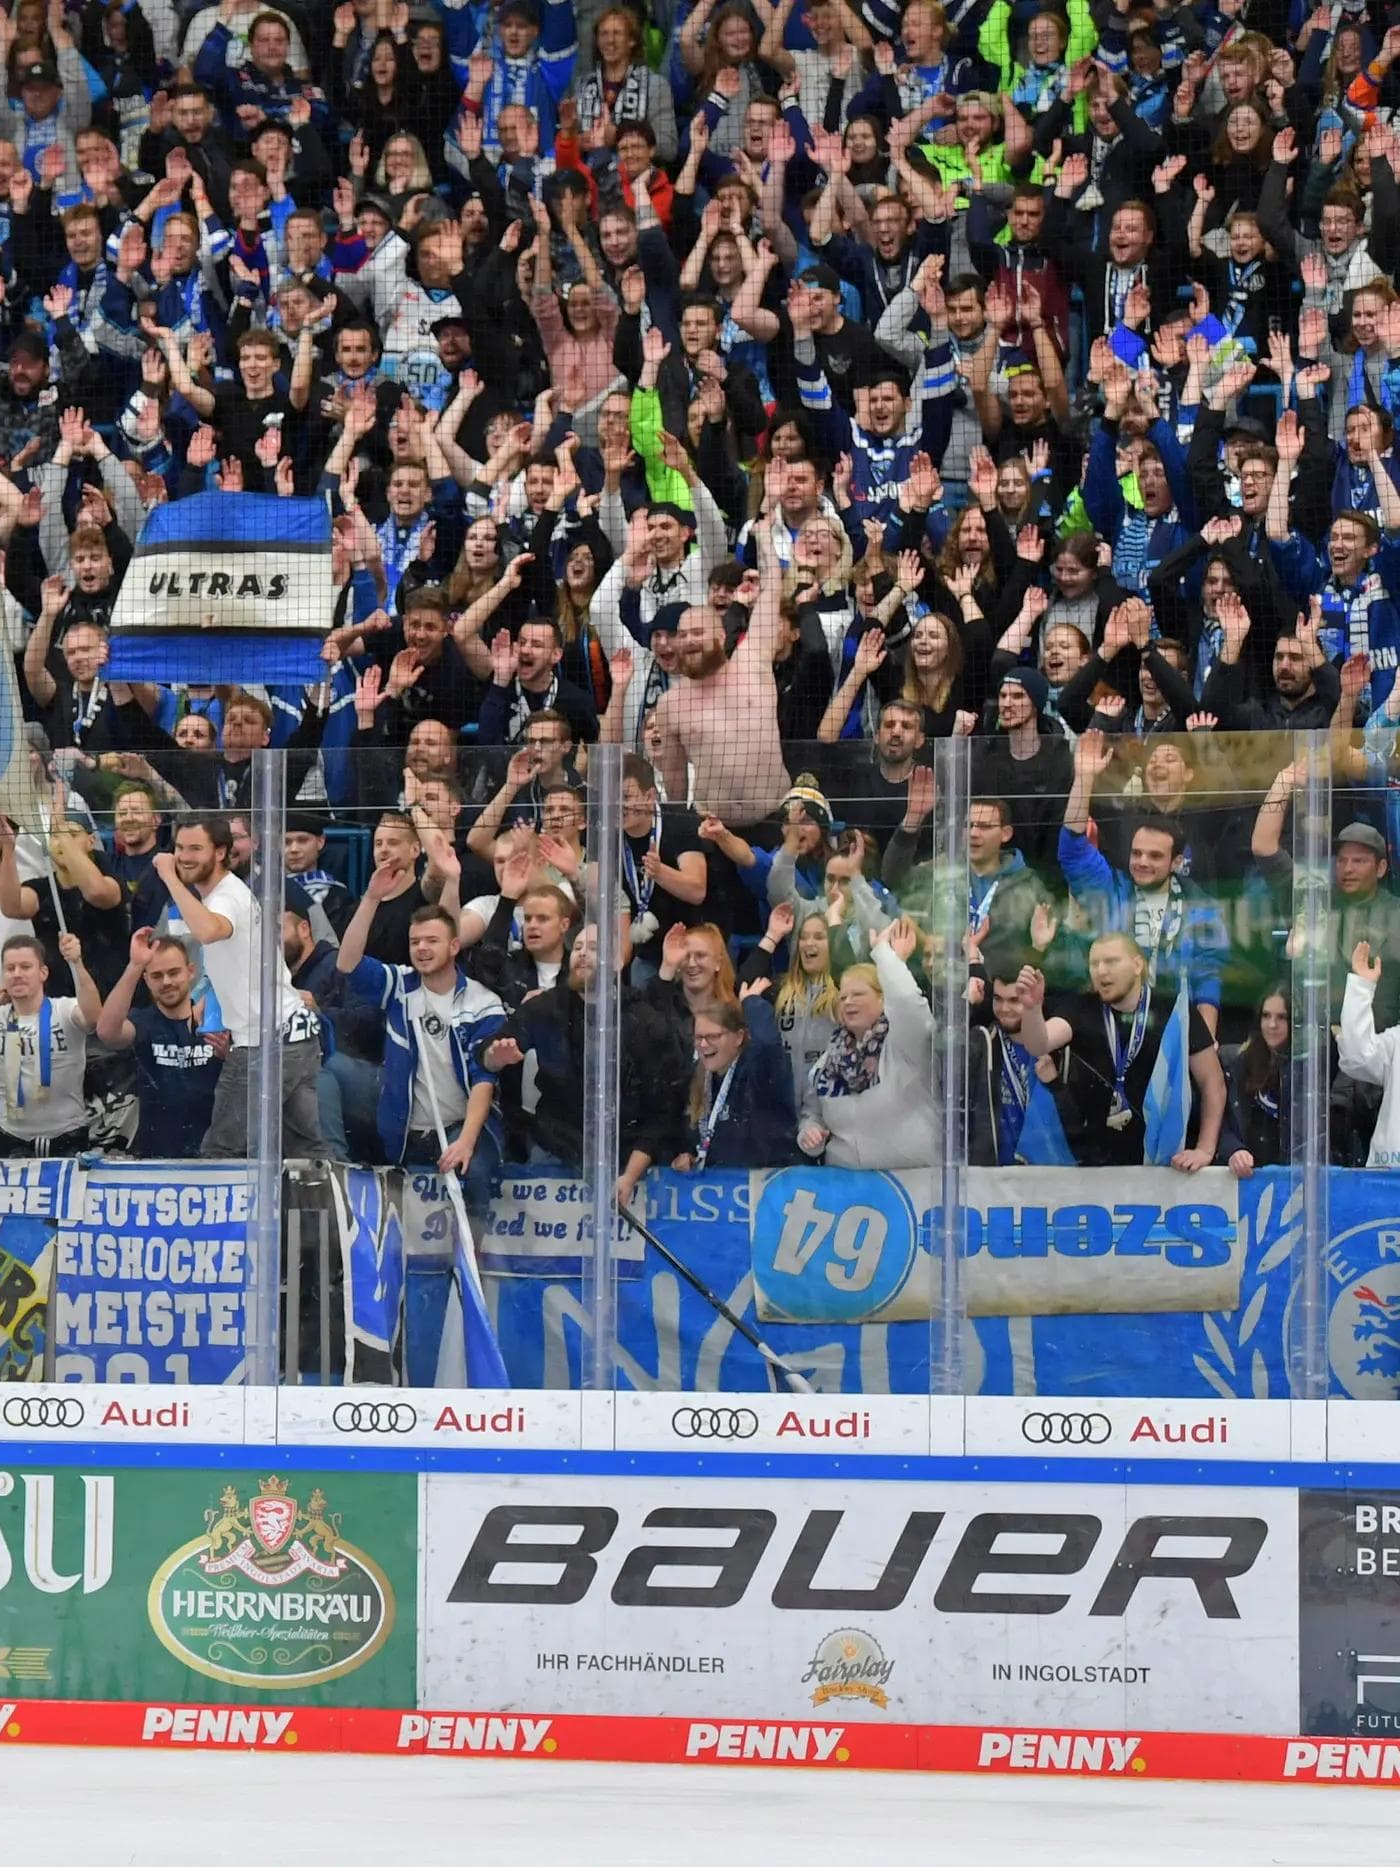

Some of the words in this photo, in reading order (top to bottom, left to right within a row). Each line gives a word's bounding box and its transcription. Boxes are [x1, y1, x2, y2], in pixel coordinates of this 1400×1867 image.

[149, 571, 290, 600] ULTRAS
[59, 1185, 264, 1228] EUTSCHE
[513, 1185, 547, 1201] we
[534, 1220, 568, 1240] we
[772, 1189, 888, 1292] 64
[100, 1400, 190, 1428] Audi
[433, 1405, 525, 1433] Audi
[776, 1410, 870, 1439] Audi
[1129, 1415, 1228, 1444] Audi
[173, 1589, 371, 1624] HERRNBRÄU
[536, 1653, 569, 1670] IHR
[577, 1651, 725, 1674] FACHHÄNDLER
[801, 1655, 895, 1687] Fairplay
[992, 1664, 1012, 1681] IN
[1019, 1664, 1151, 1685] INGOLSTADT
